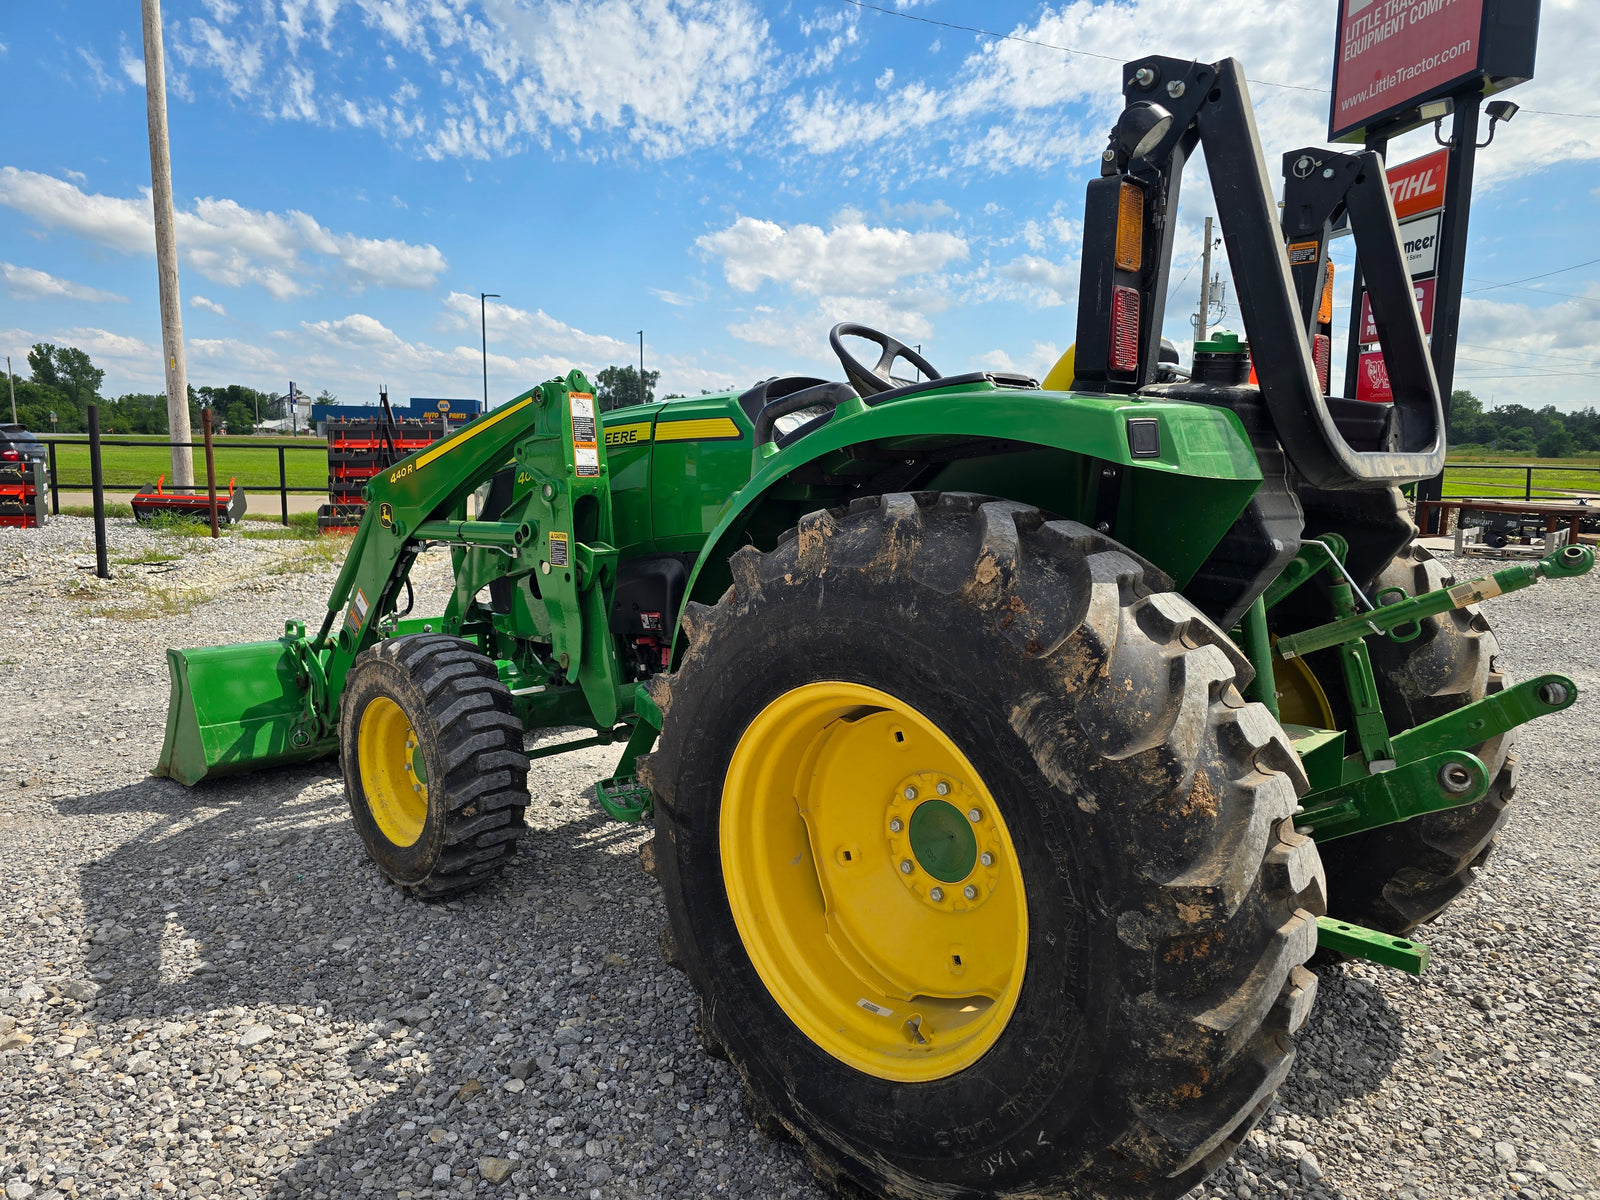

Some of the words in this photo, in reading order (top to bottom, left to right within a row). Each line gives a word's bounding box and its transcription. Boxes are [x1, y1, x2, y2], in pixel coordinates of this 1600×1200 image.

[1344, 11, 1407, 62] EQUIPMENT
[1410, 0, 1456, 25] COMP
[1345, 7, 1382, 44] LITTLE
[1341, 39, 1471, 111] www.LittleTractor.com
[1388, 168, 1437, 202] TIHL
[1403, 235, 1436, 254] meer
[423, 411, 440, 419] AUTO
[448, 412, 467, 420] PARTS
[605, 430, 638, 444] EERE
